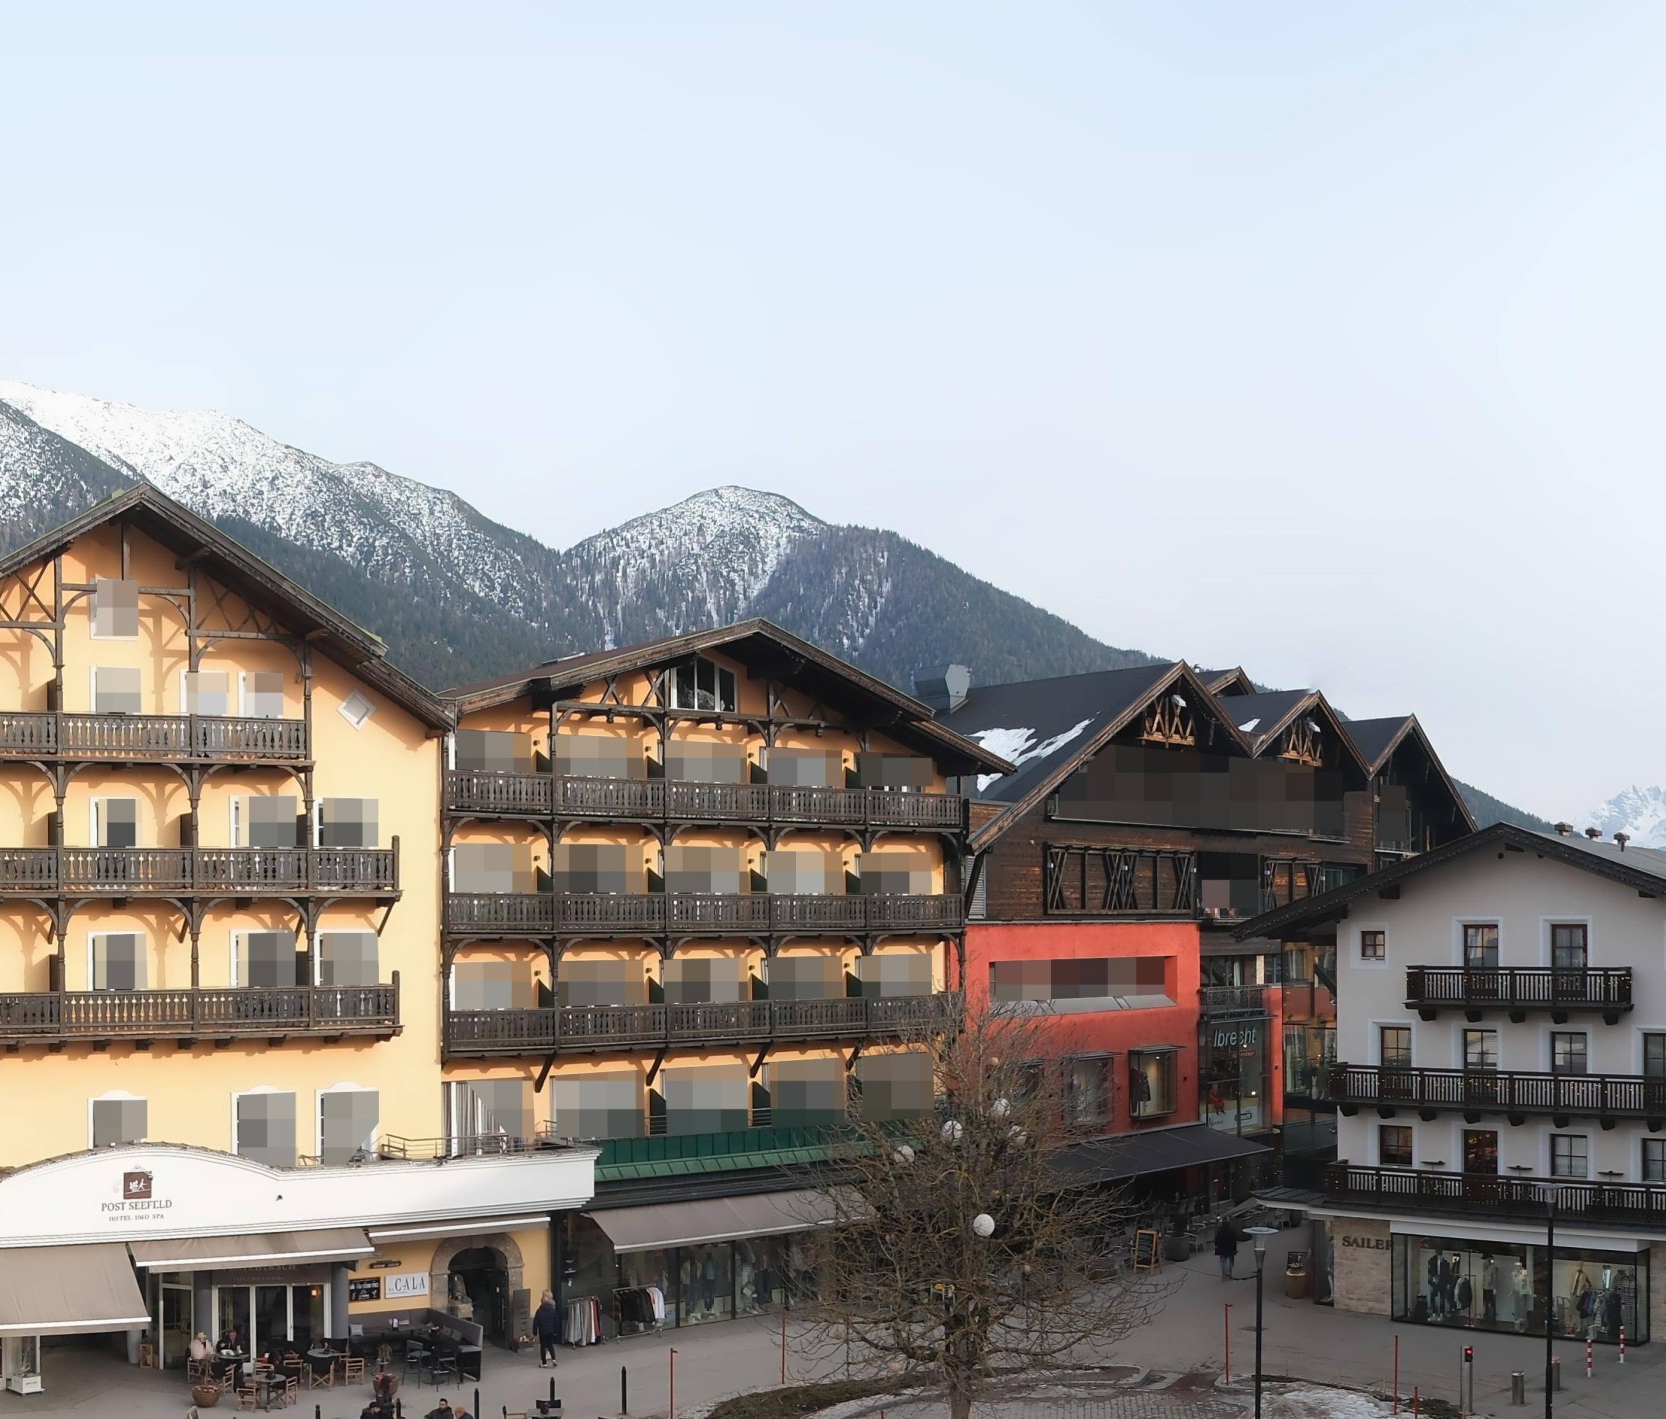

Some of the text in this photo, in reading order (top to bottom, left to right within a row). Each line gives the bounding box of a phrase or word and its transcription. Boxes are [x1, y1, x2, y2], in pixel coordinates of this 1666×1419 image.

[101, 1200, 173, 1212] POST SEEFELD
[395, 1277, 425, 1291] CALA
